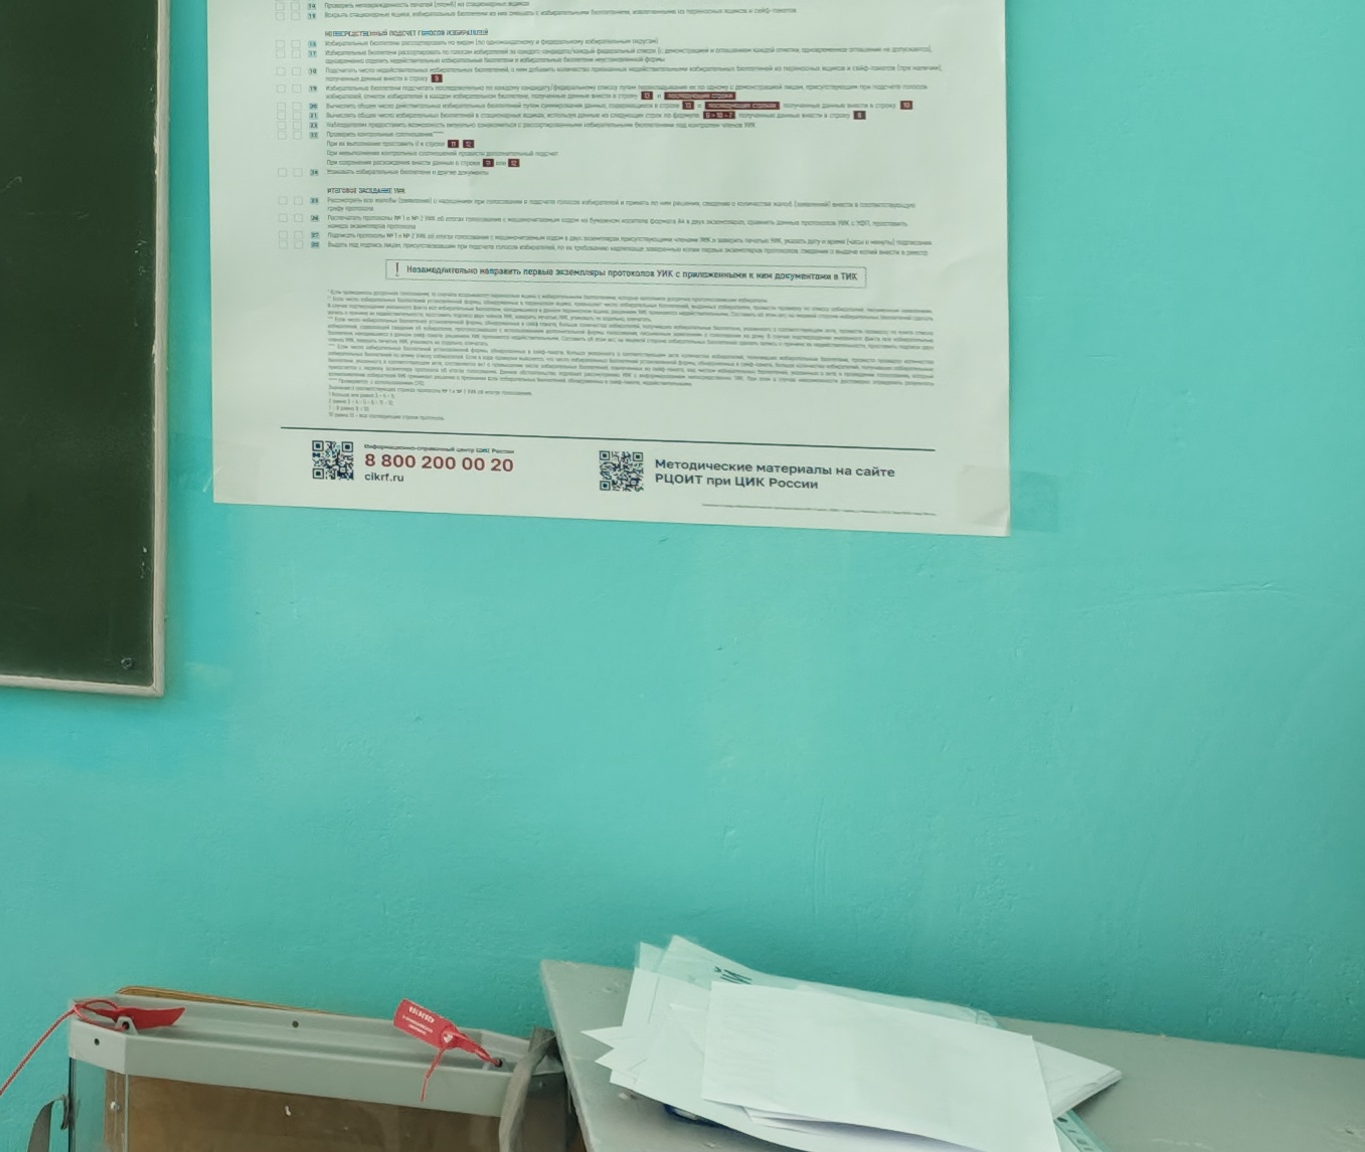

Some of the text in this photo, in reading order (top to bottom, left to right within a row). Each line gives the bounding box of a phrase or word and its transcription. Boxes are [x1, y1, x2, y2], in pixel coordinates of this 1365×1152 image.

[365, 454, 514, 472] 8 800 200 00 20
[655, 459, 895, 477] Методические материалы на сайте
[365, 472, 404, 482] cikrf.ru
[655, 474, 818, 489] РЦОИТ при ЦИК России
